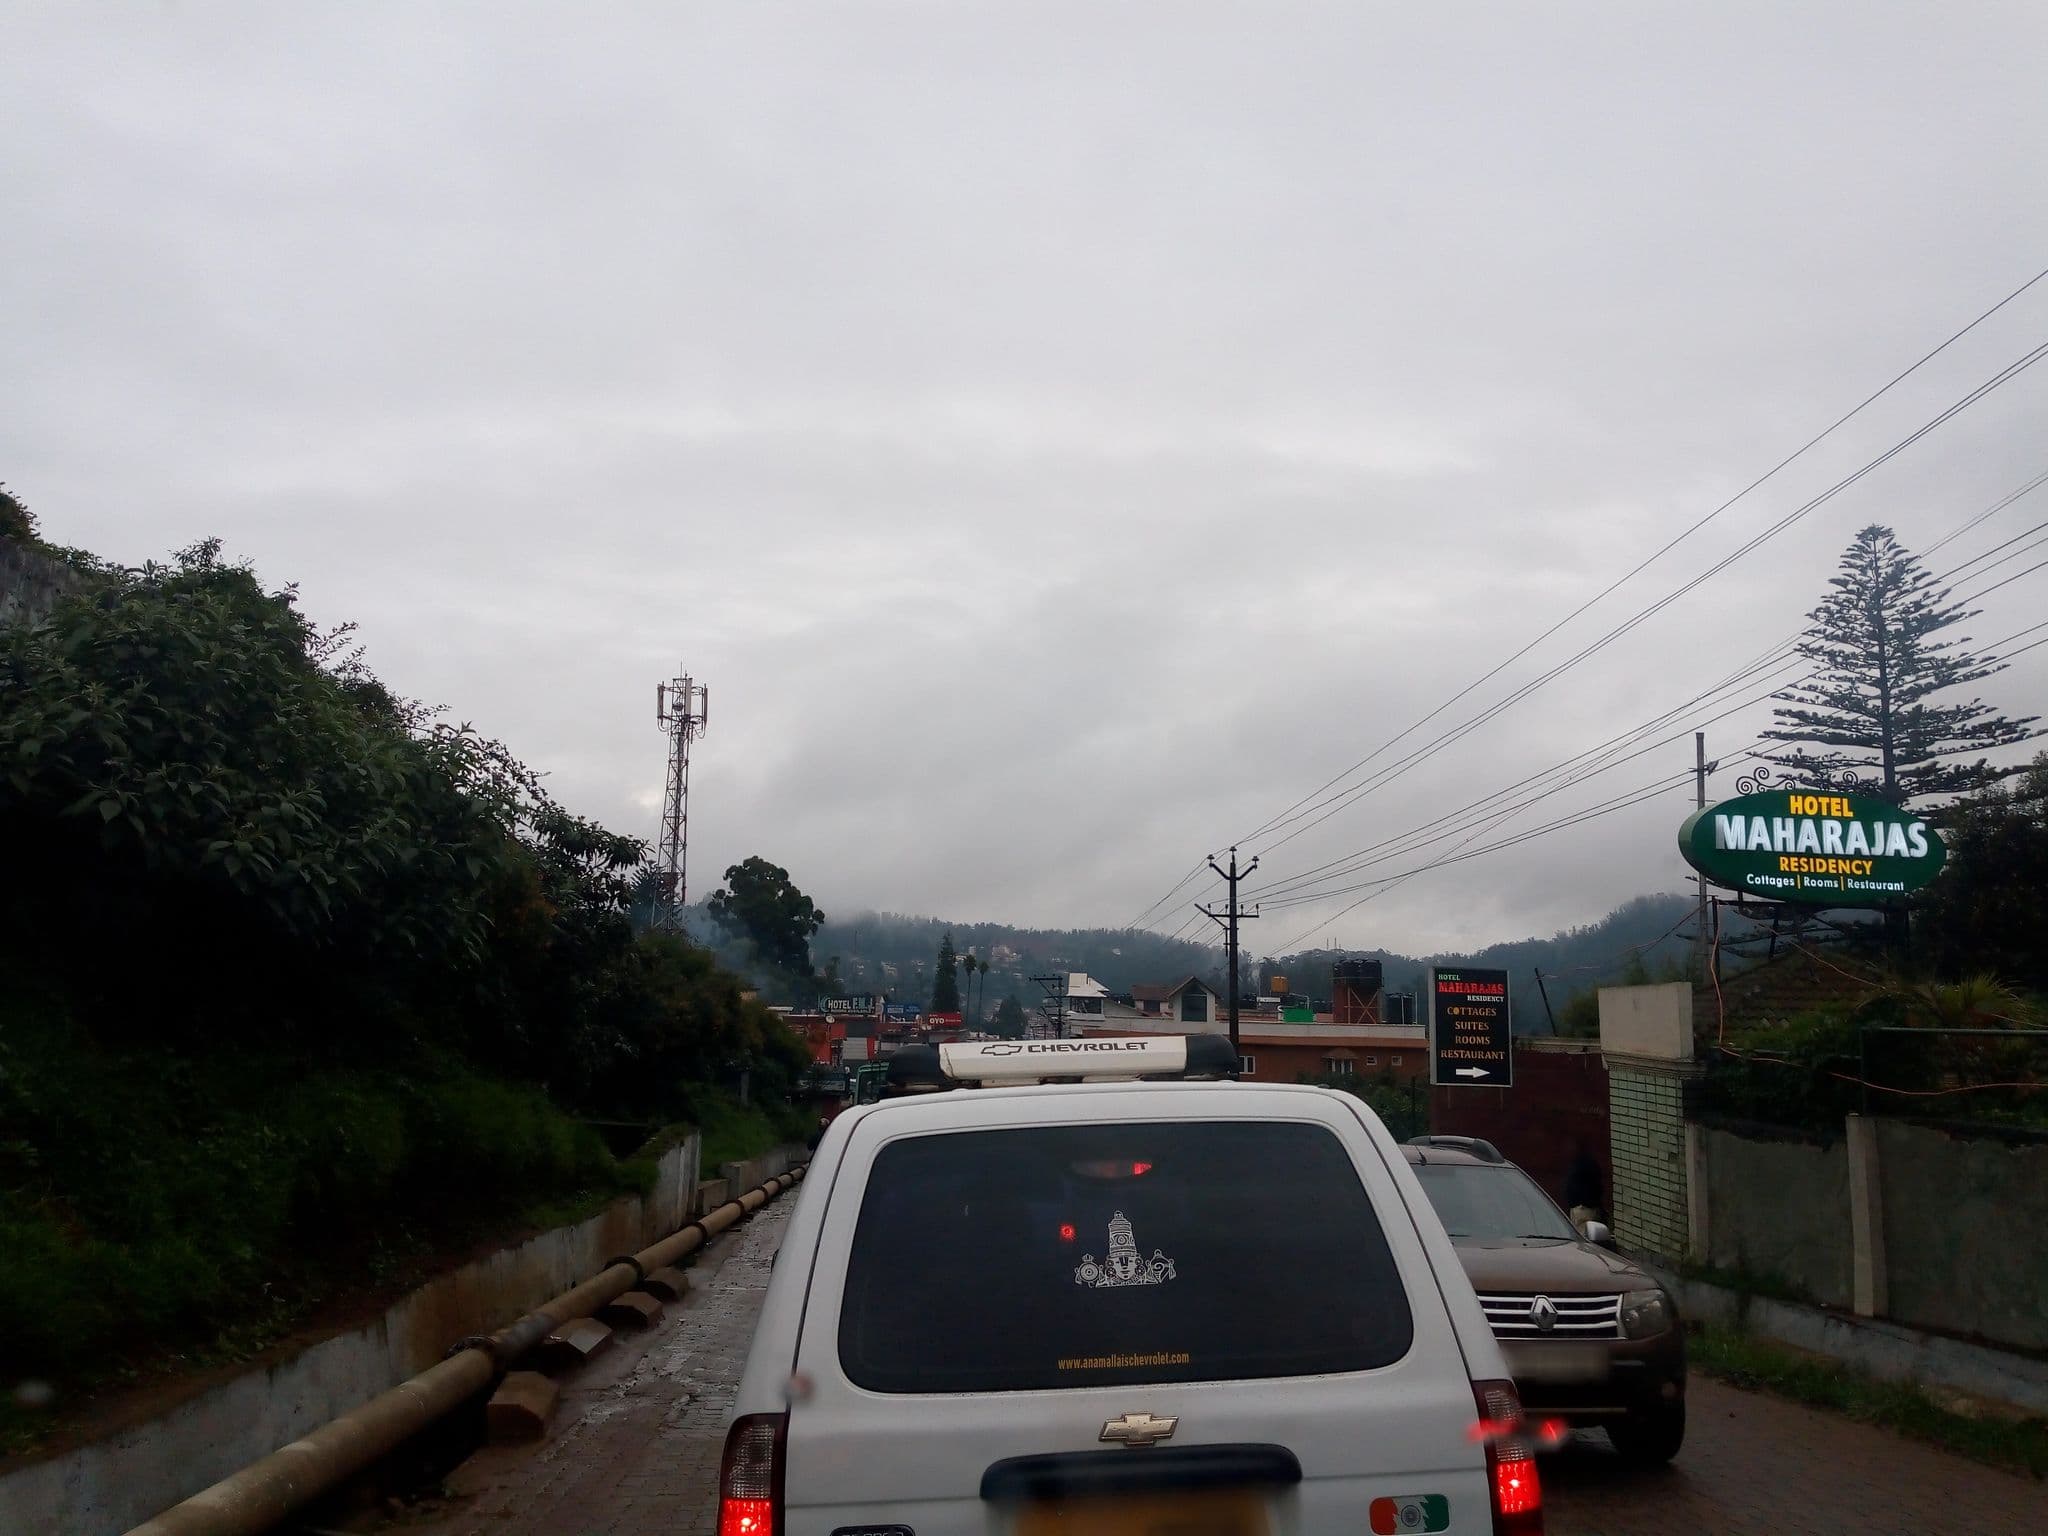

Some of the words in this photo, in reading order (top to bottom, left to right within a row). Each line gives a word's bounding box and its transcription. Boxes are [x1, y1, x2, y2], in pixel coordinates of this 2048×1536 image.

[1790, 795, 1854, 817] HOTEL
[1714, 814, 1929, 858] MAHARAJAS
[1779, 856, 1873, 875] RESIDENCY
[1746, 873, 1795, 887] Cottages
[1803, 876, 1839, 888] Rooms
[1847, 878, 1904, 891] Restaurant
[1438, 981, 1505, 995] MAHARAJAS
[827, 999, 851, 1009] HOTEL
[1447, 1006, 1497, 1016] COTTAGES
[1455, 1021, 1489, 1030] SUITES
[1455, 1036, 1490, 1045] ROOMS
[1028, 1042, 1149, 1053] CHEVROLET
[1440, 1050, 1505, 1060] RESTAURANT
[1057, 1352, 1190, 1369] www.anamallaischevrolet.com
